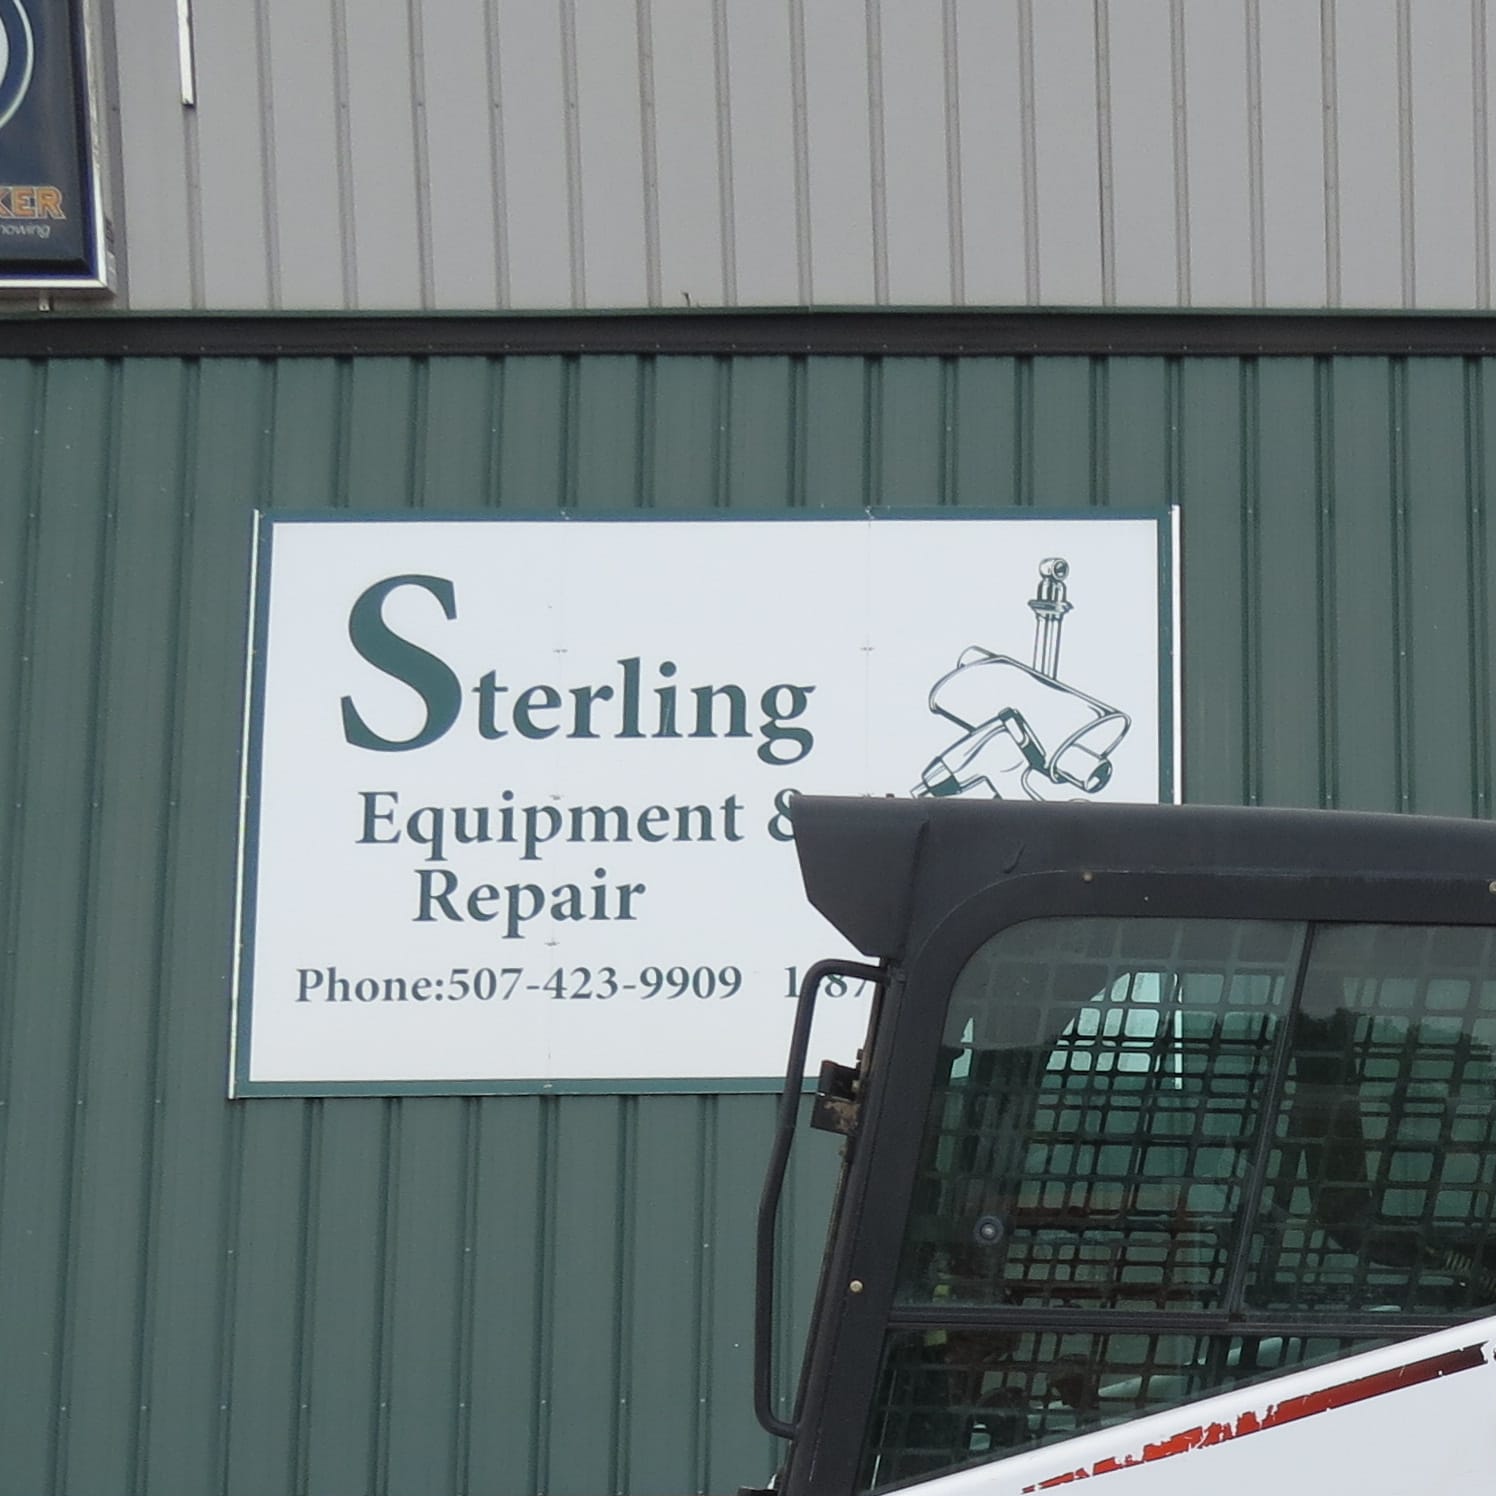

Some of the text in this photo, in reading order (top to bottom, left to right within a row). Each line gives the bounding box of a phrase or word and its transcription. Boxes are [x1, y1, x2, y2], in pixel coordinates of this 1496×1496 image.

[341, 574, 816, 766] Sterling
[355, 790, 744, 862] Equipment
[412, 867, 646, 939] Repair
[297, 966, 743, 1002] Phone:507-423-9909
